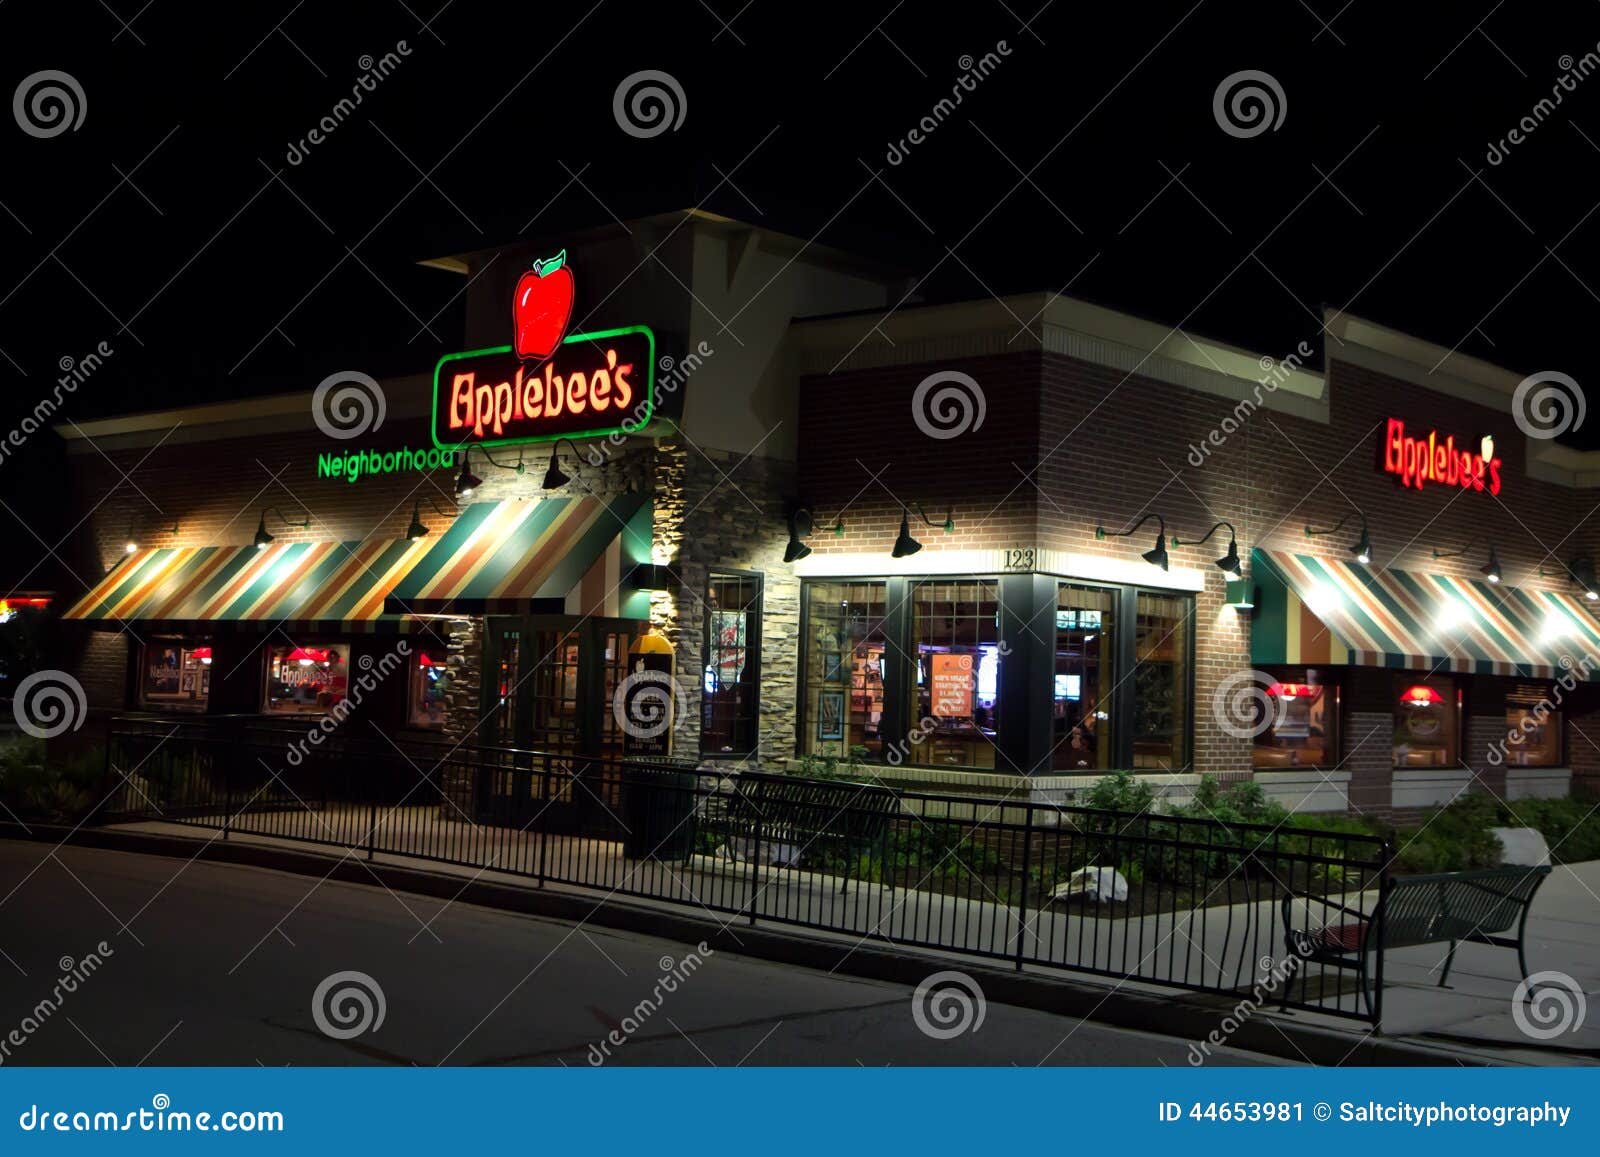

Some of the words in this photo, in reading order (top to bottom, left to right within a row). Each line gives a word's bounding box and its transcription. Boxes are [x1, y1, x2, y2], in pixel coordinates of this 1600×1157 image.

[450, 349, 633, 438] Applebee's
[318, 446, 454, 483] Neighborhood
[1385, 418, 1502, 497] Applebee's
[1004, 549, 1034, 569] 123
